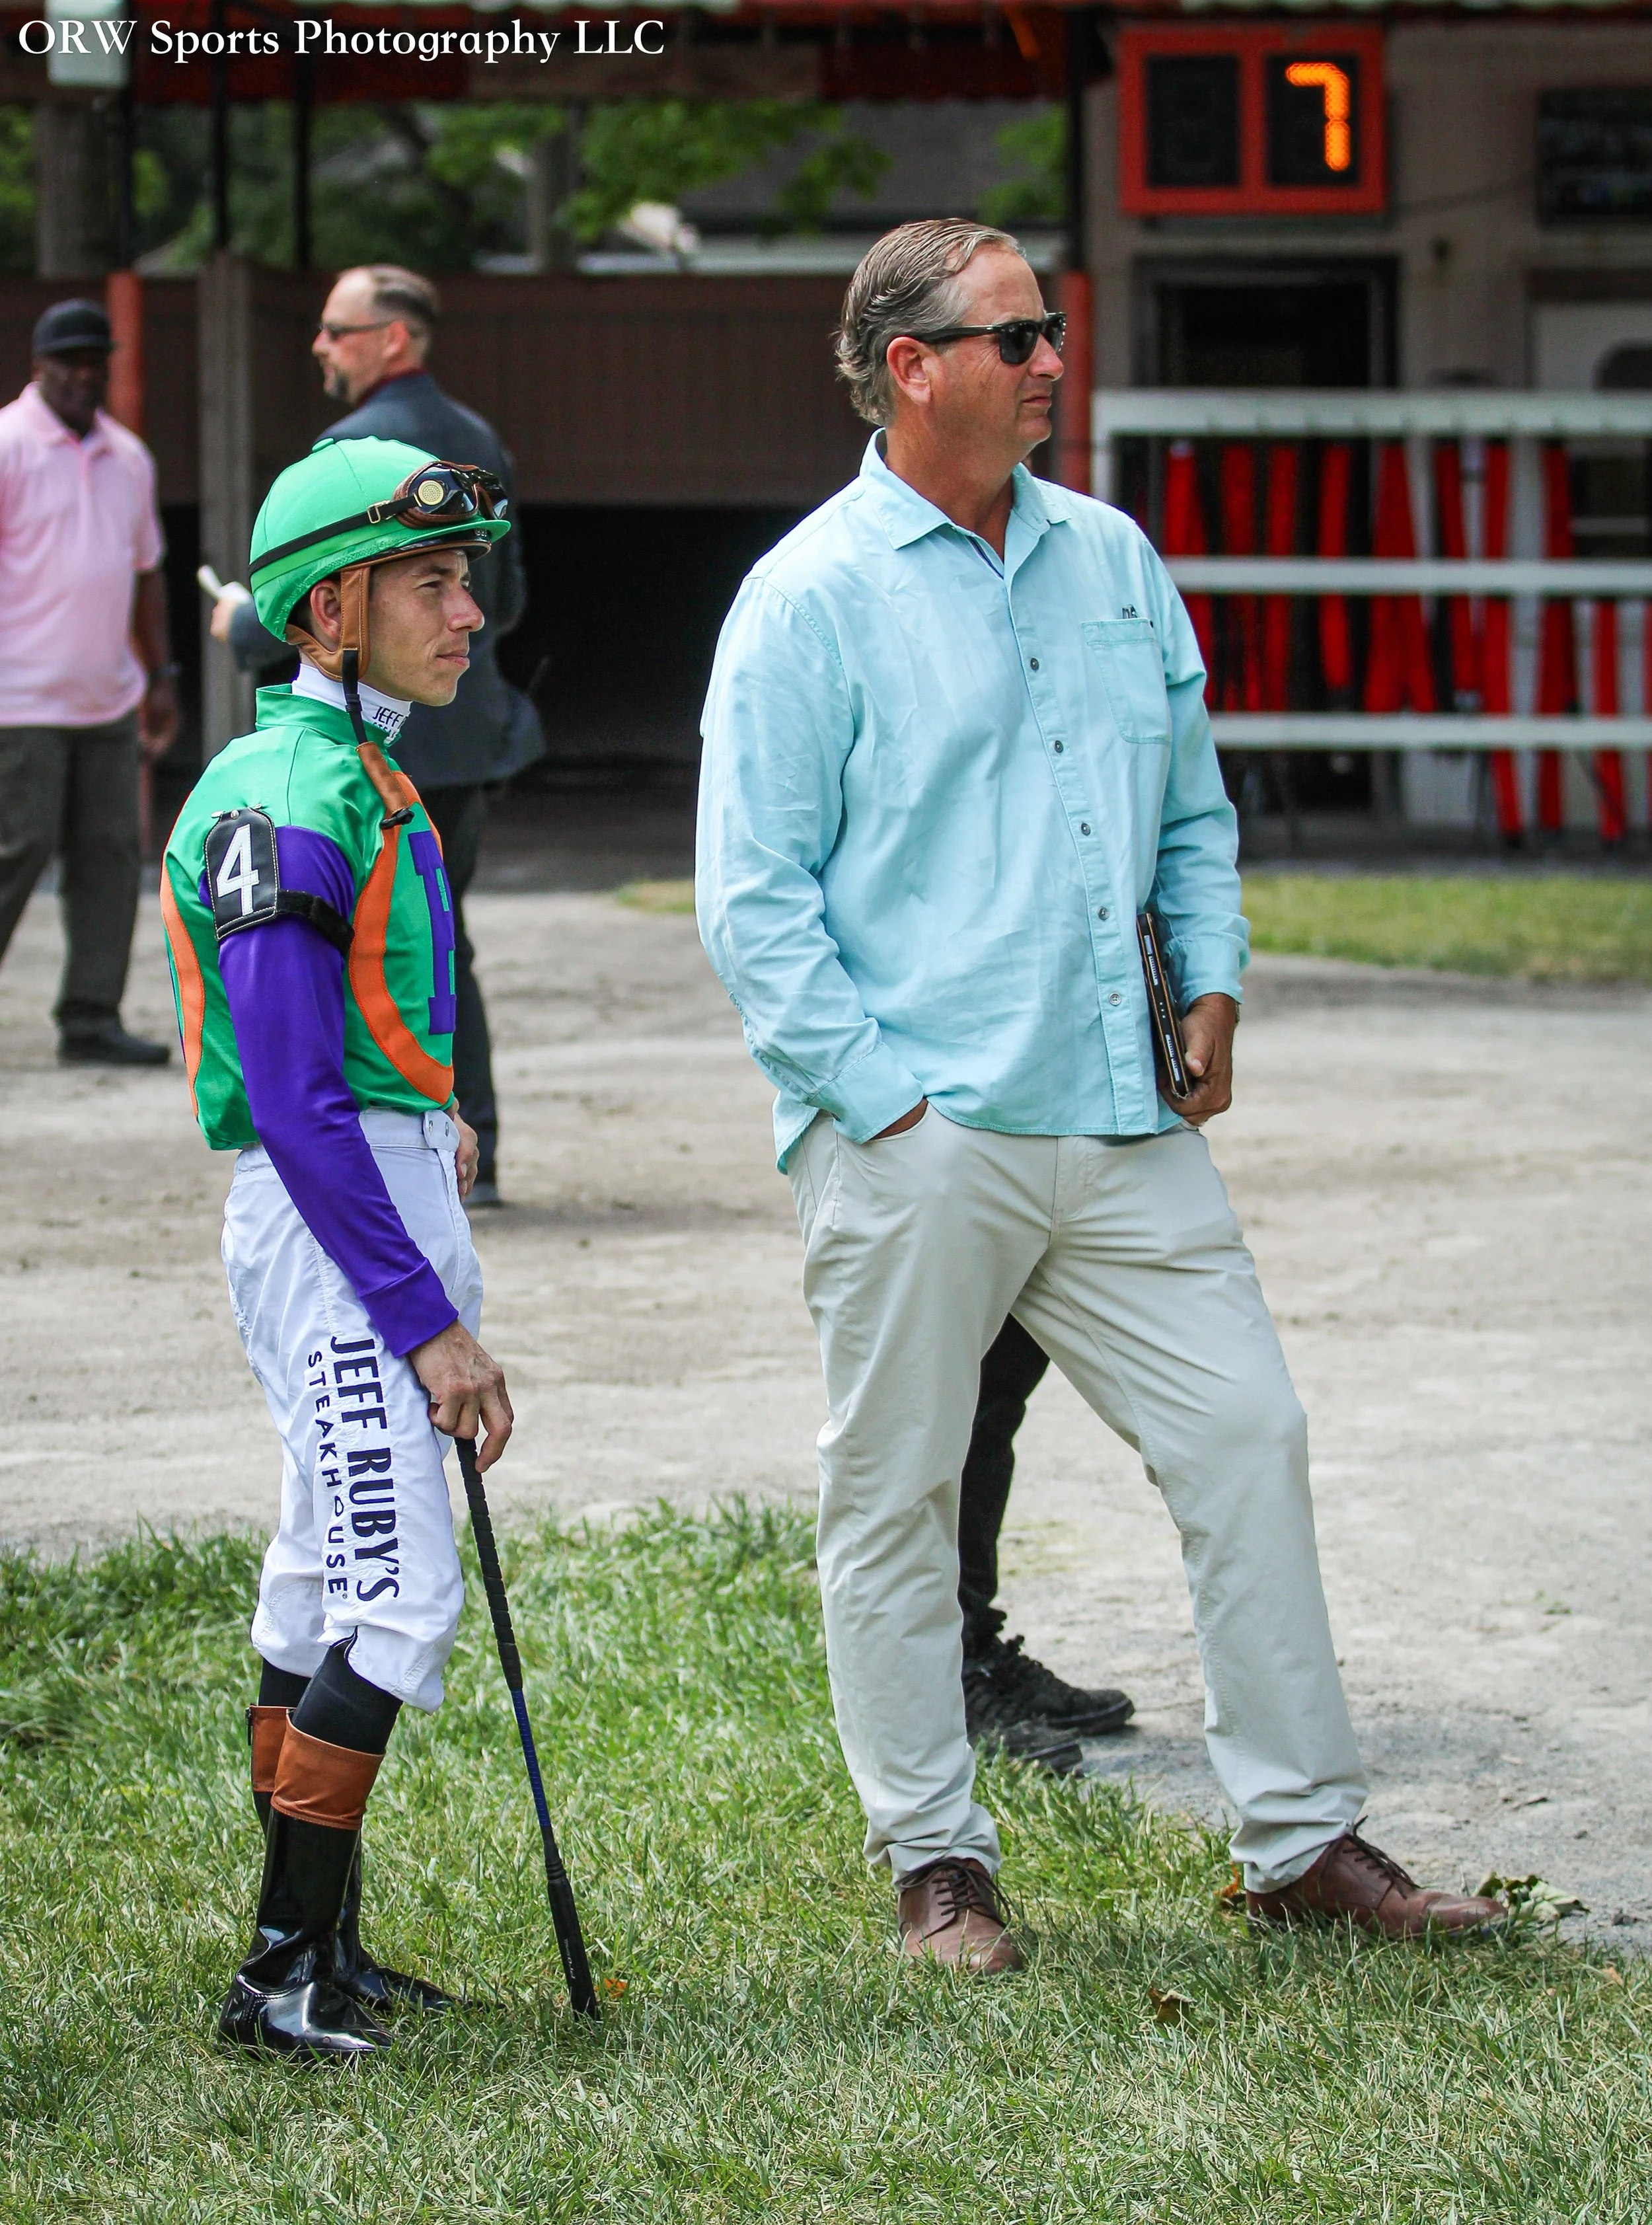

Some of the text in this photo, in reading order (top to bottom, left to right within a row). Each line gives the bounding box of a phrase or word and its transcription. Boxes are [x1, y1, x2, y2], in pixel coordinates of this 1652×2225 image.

[1285, 63, 1350, 171] 7
[372, 706, 404, 728] JEFF
[217, 823, 260, 917] 4
[308, 1351, 348, 1594] STEAKHOUSE
[330, 1336, 400, 1602] JEFF RUBY'S
